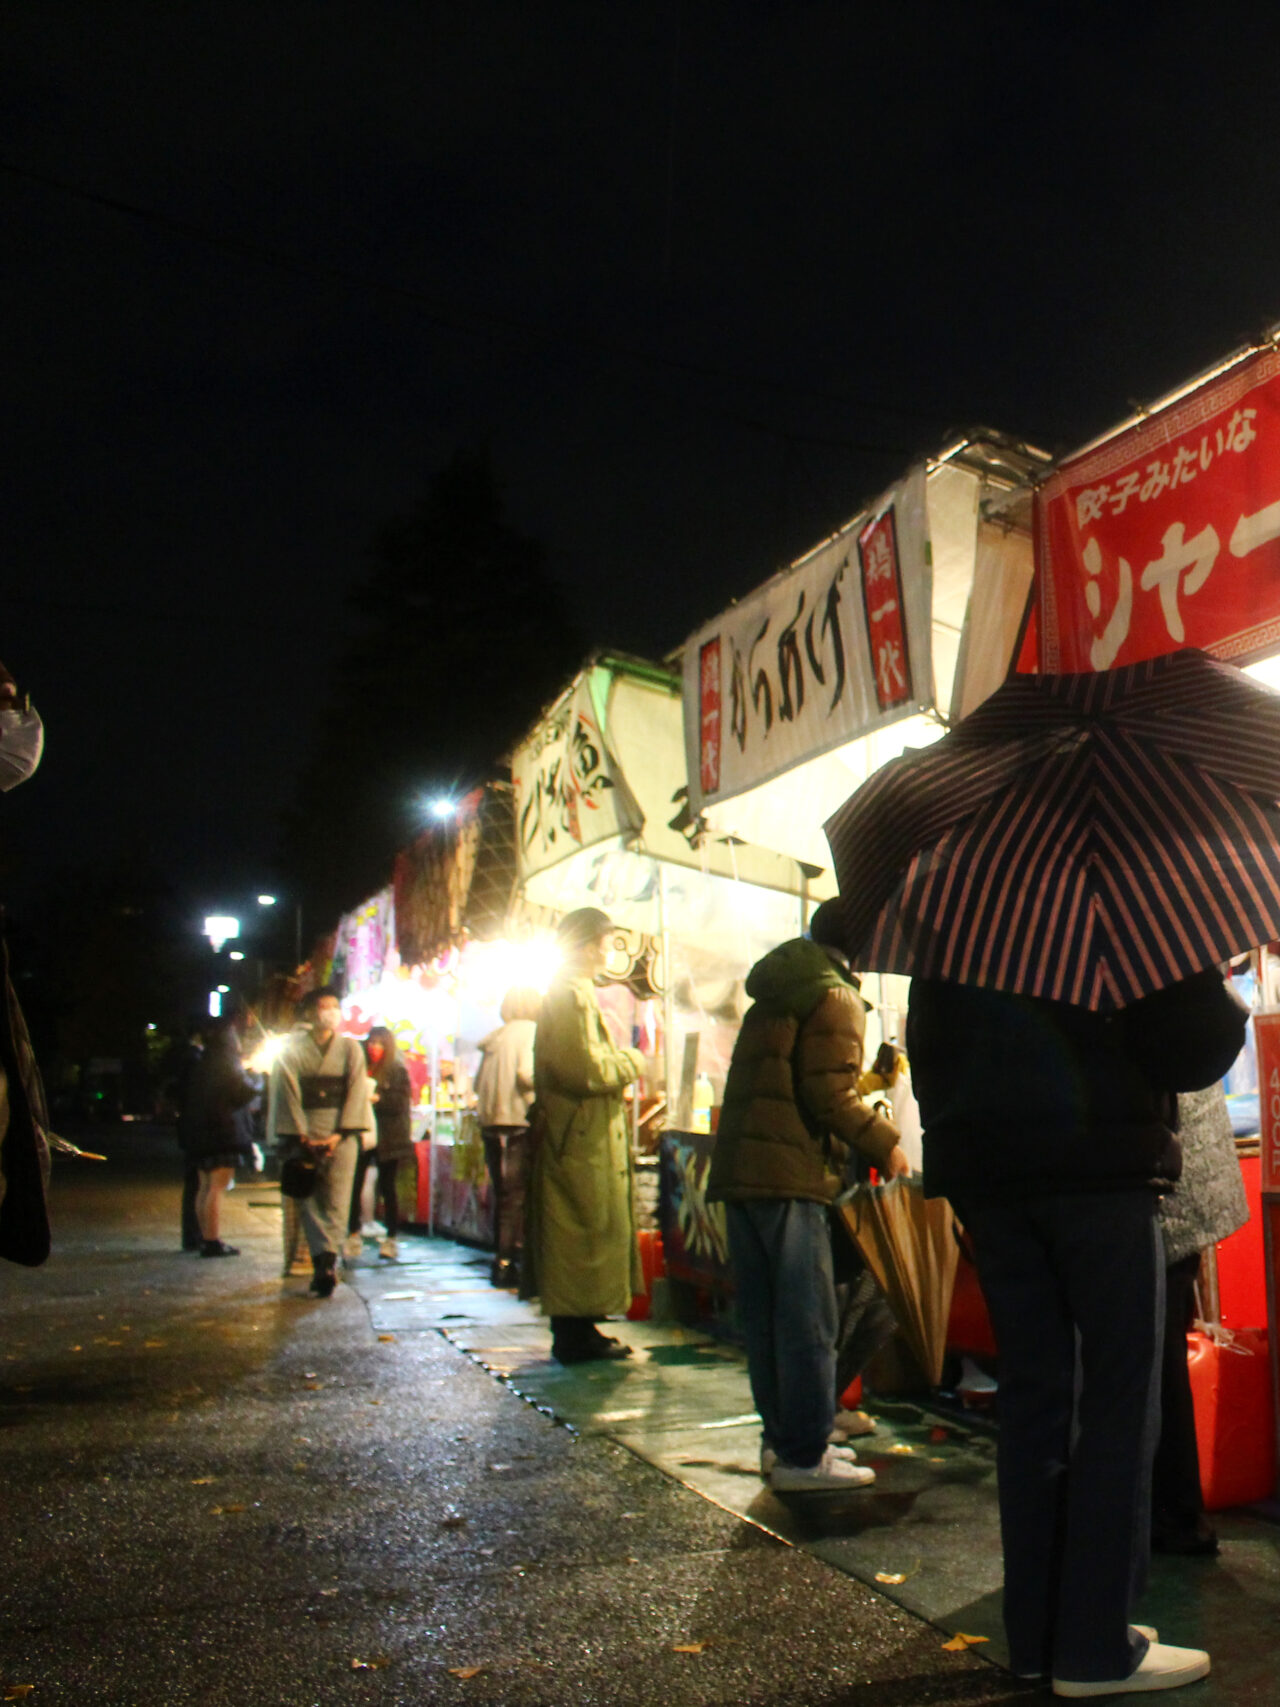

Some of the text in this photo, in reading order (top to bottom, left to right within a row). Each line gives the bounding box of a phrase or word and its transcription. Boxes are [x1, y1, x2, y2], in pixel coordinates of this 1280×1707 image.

[1076, 408, 1257, 531] 餃子みたいな
